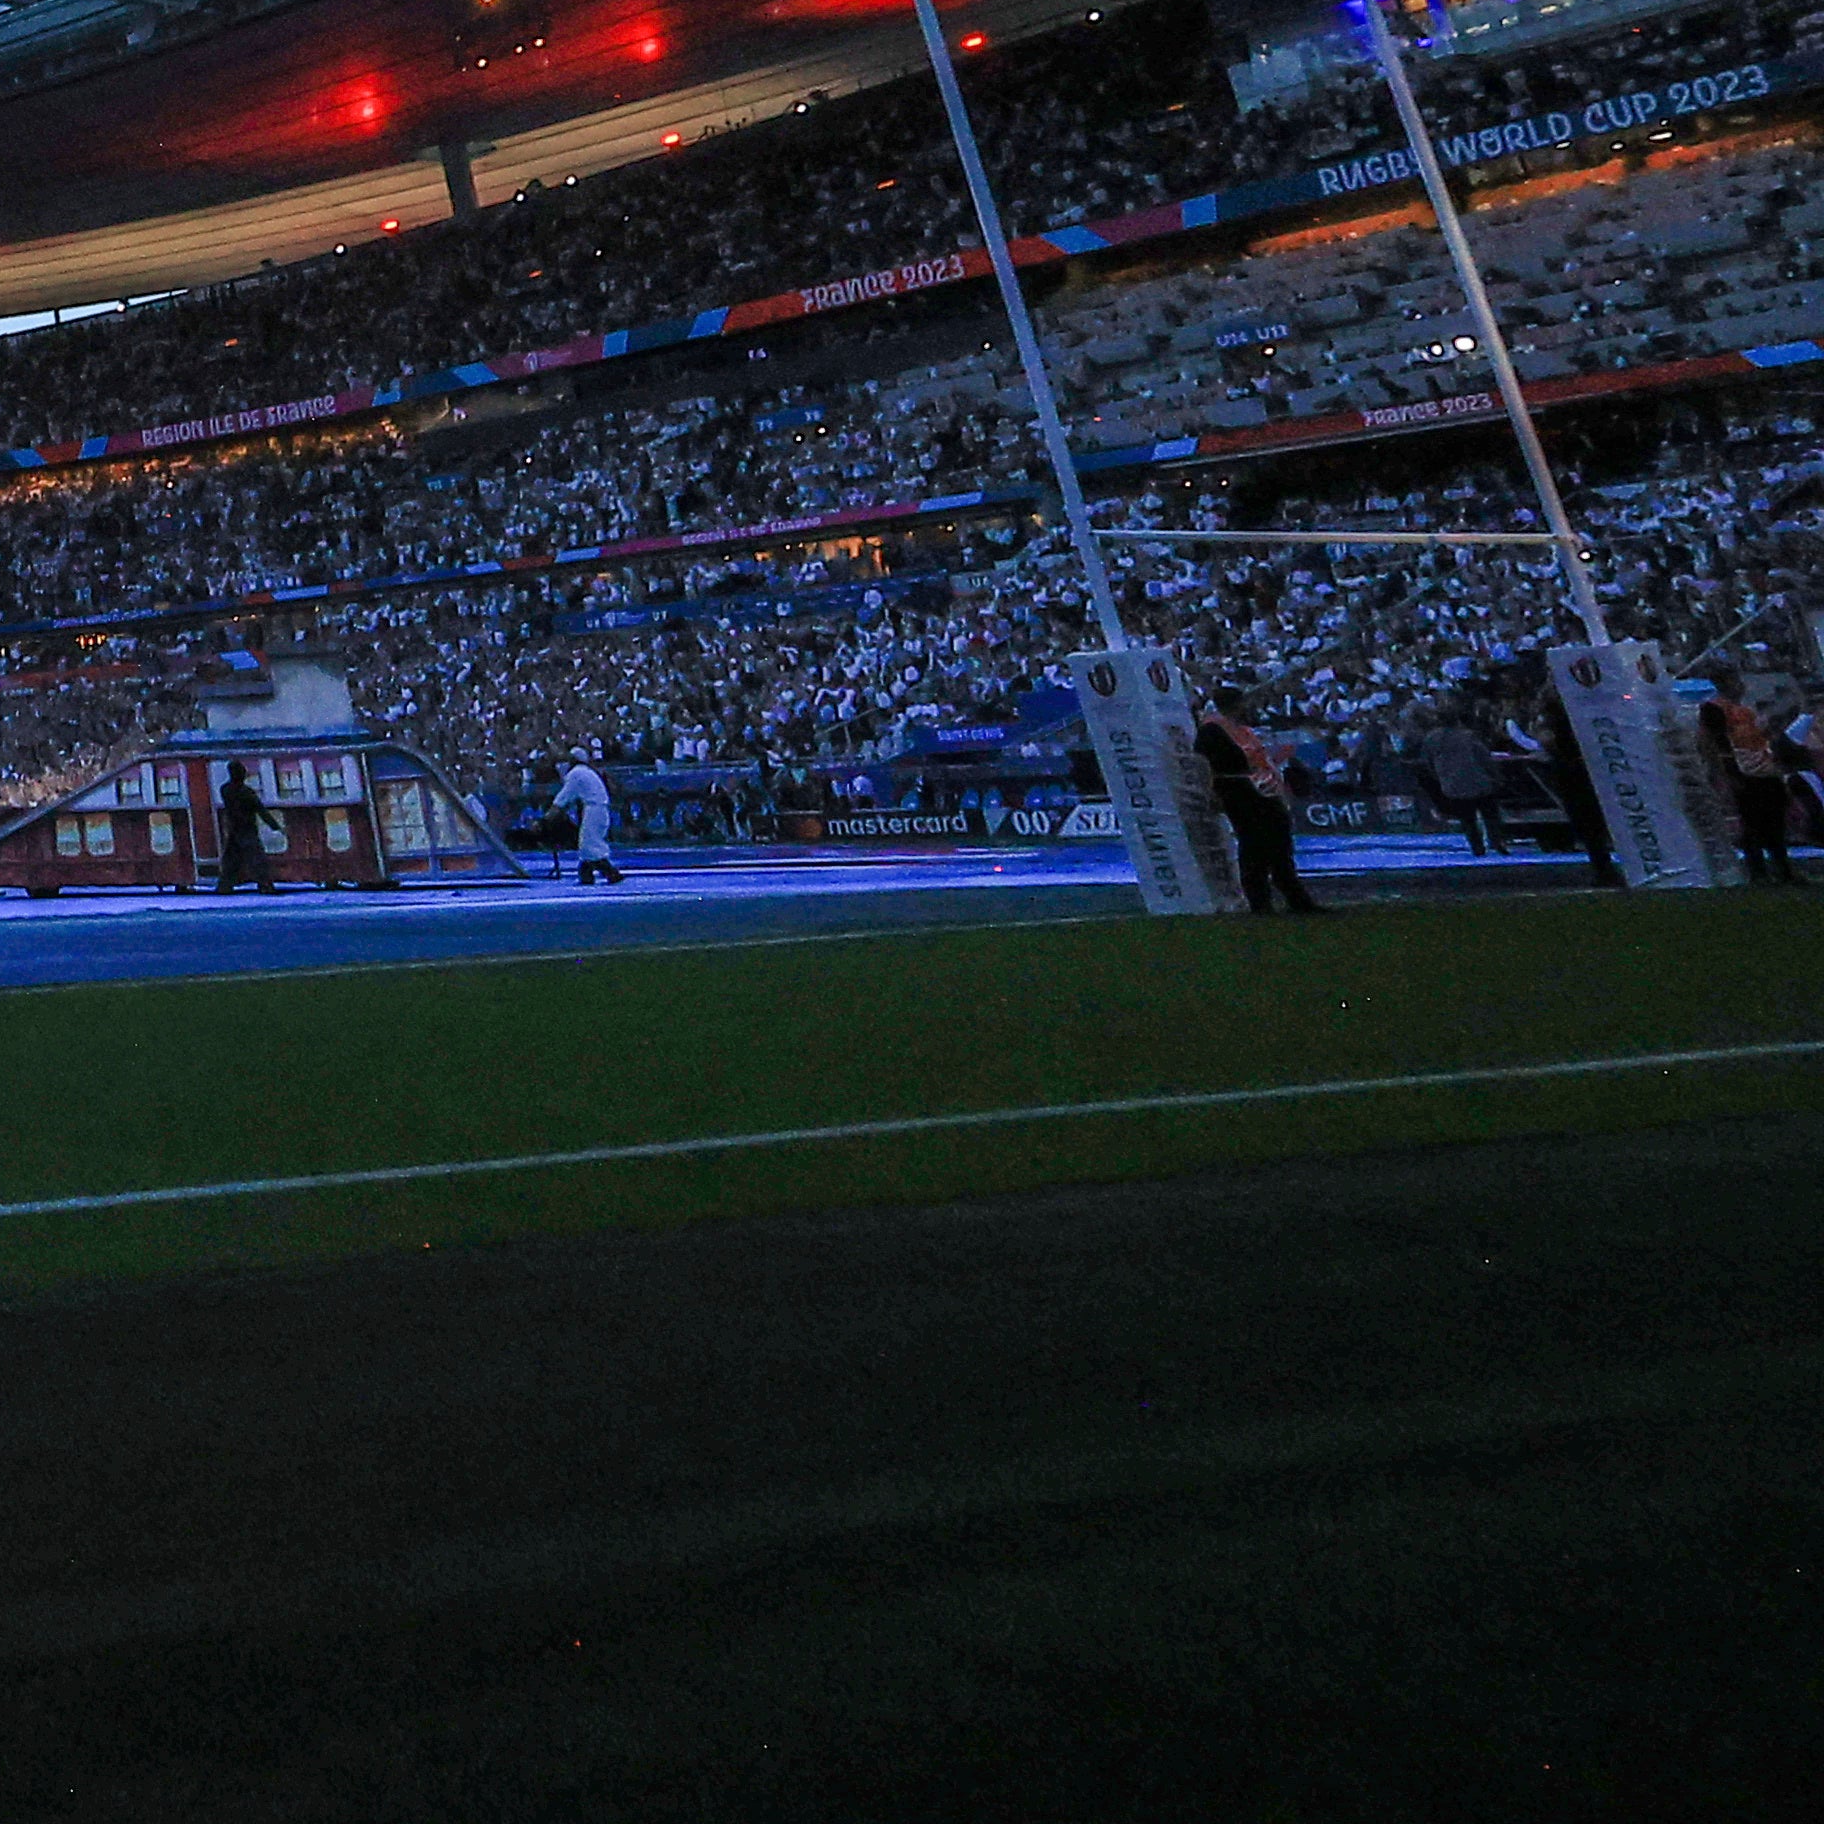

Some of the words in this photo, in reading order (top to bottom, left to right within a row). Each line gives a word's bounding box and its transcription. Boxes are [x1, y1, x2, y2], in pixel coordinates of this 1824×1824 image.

[1438, 112, 1572, 167] WORLD
[1583, 90, 1659, 135] CUP
[1667, 64, 1770, 114] 2023
[902, 254, 965, 290] 2023
[1441, 391, 1493, 415] 2023
[239, 408, 263, 430] DE
[827, 810, 969, 837] mastercard
[1305, 802, 1368, 827] GMF
